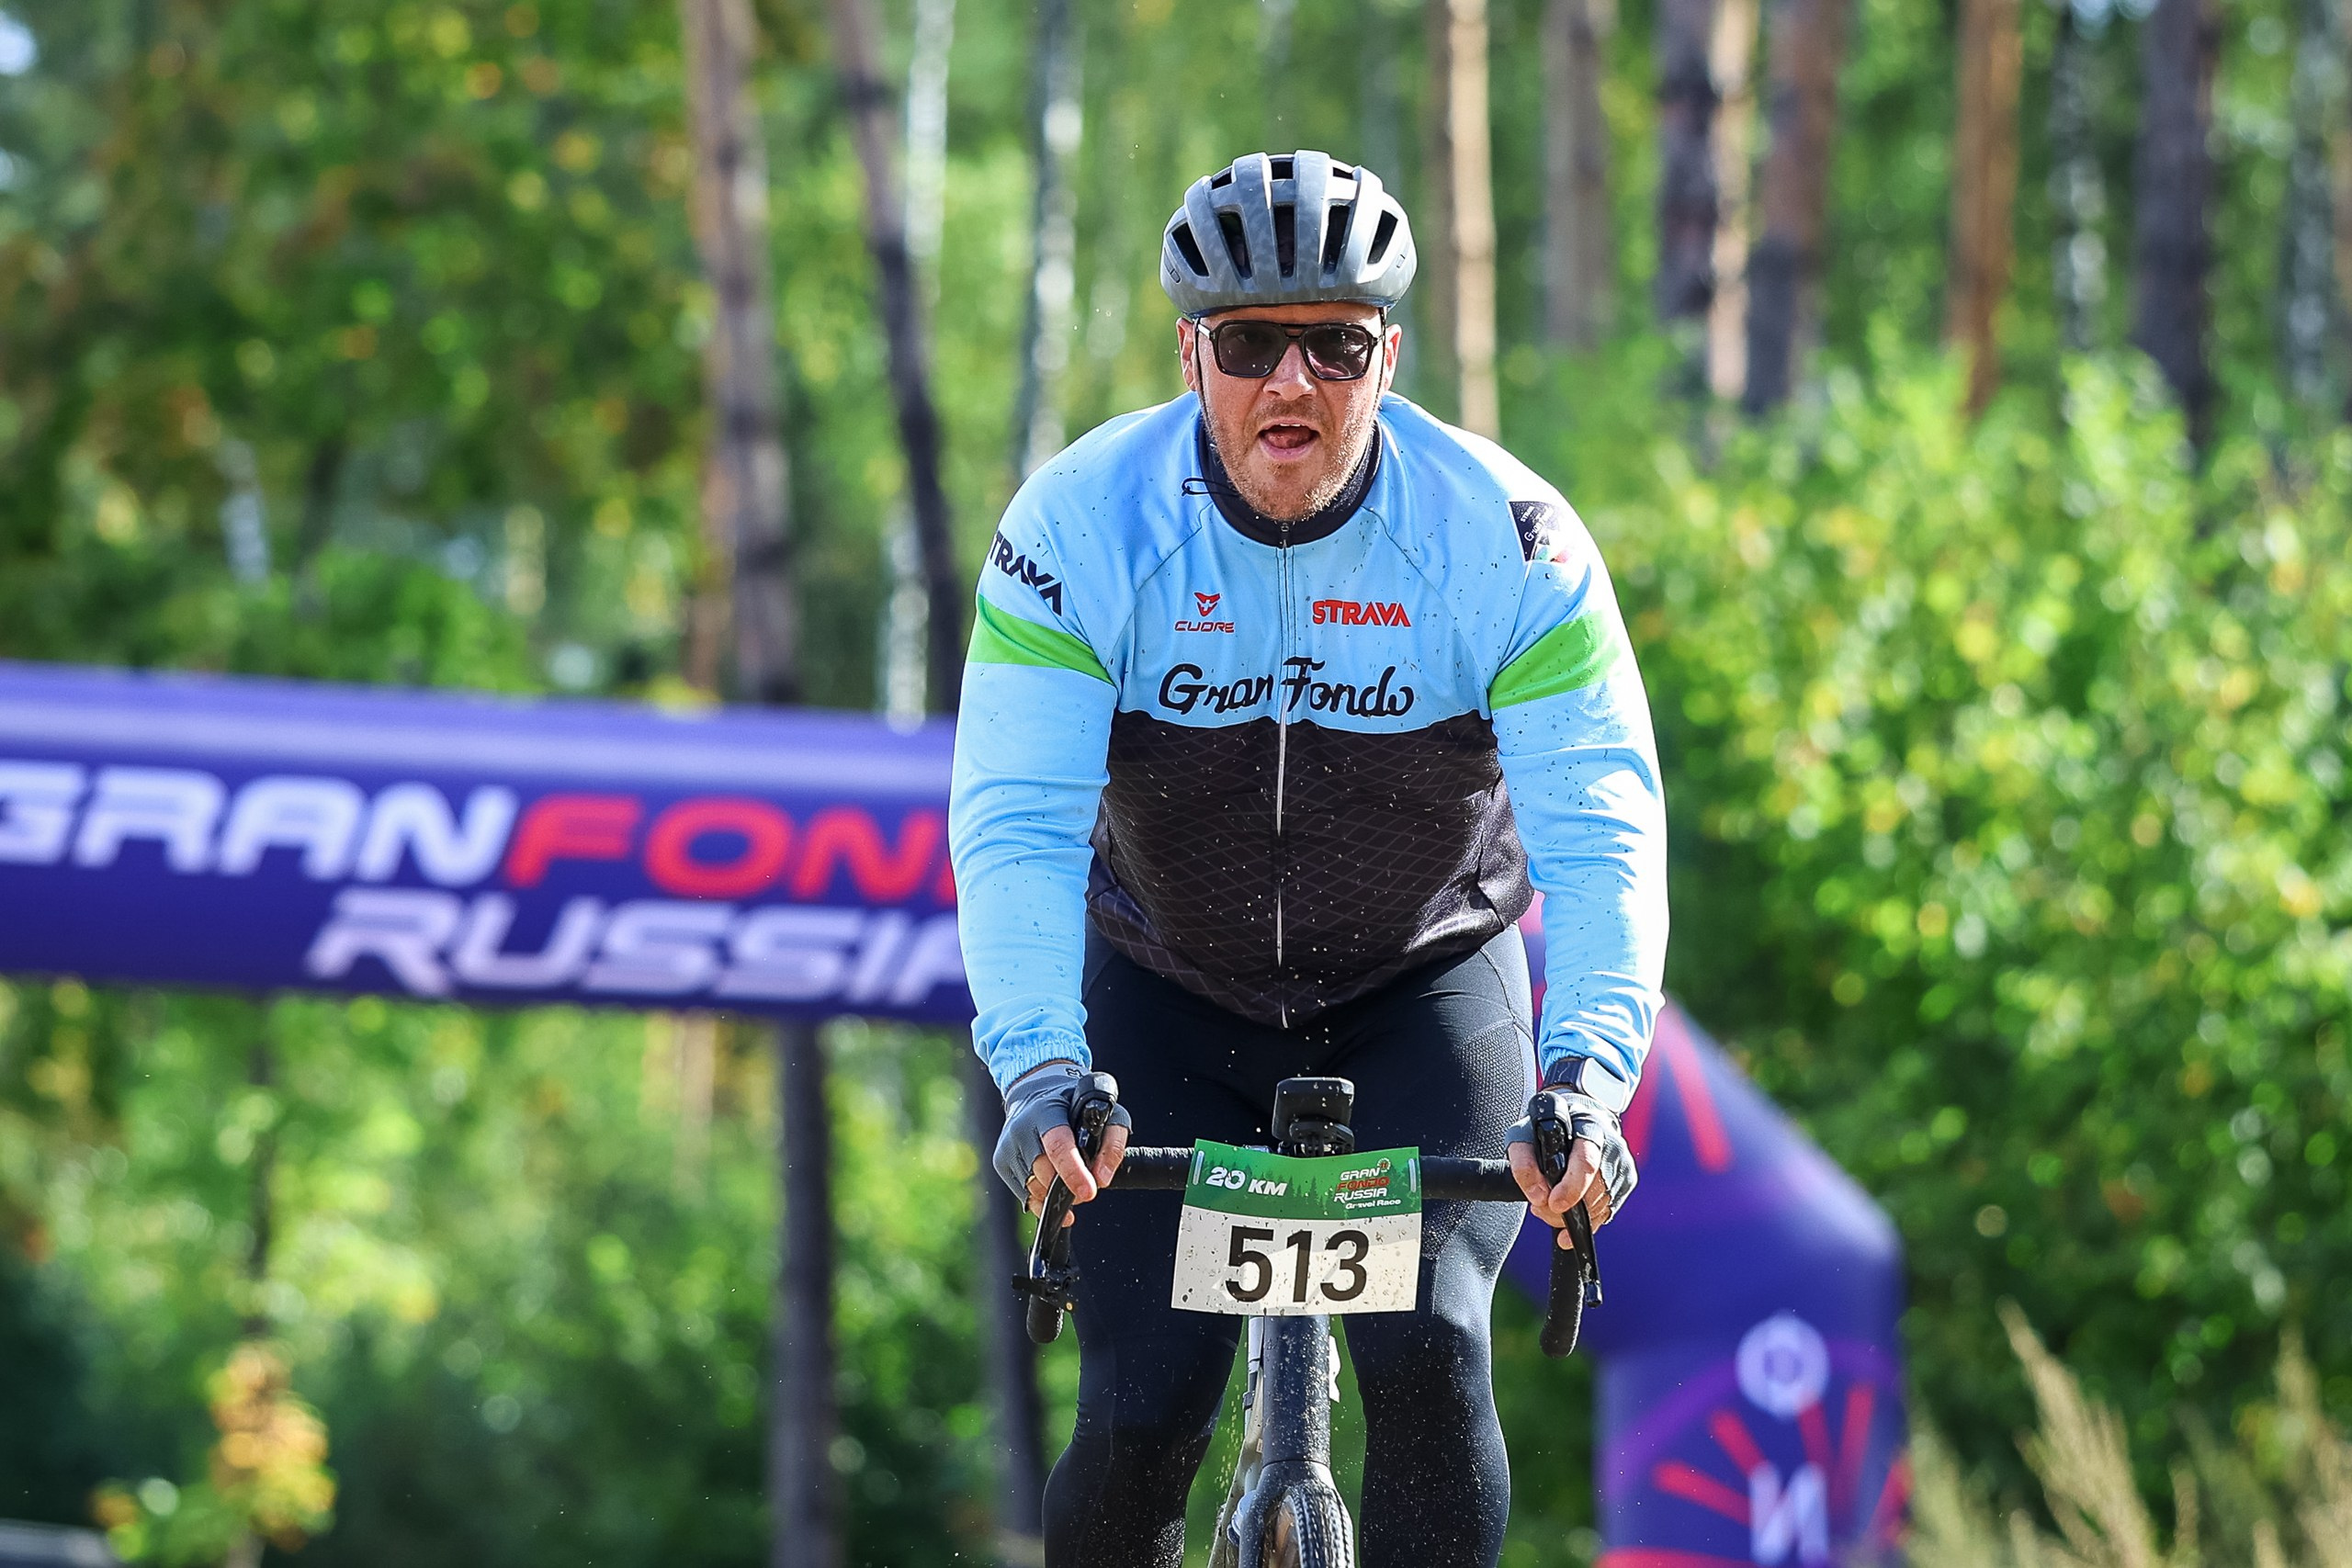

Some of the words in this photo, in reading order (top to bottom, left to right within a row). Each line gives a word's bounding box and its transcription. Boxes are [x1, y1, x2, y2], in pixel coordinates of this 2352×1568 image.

[1174, 620, 1235, 633] CUORE
[1312, 599, 1412, 627] STRAVA
[1159, 663, 1274, 715] Gran
[1281, 656, 1415, 717] Fondo
[503, 792, 956, 905] FON
[1205, 1167, 1246, 1190] 20
[1248, 1179, 1288, 1197] KM
[1340, 1168, 1381, 1181] GRAN
[1334, 1188, 1387, 1203] RUSSIA
[1345, 1201, 1375, 1209] Gravel
[1225, 1224, 1370, 1303] 513
